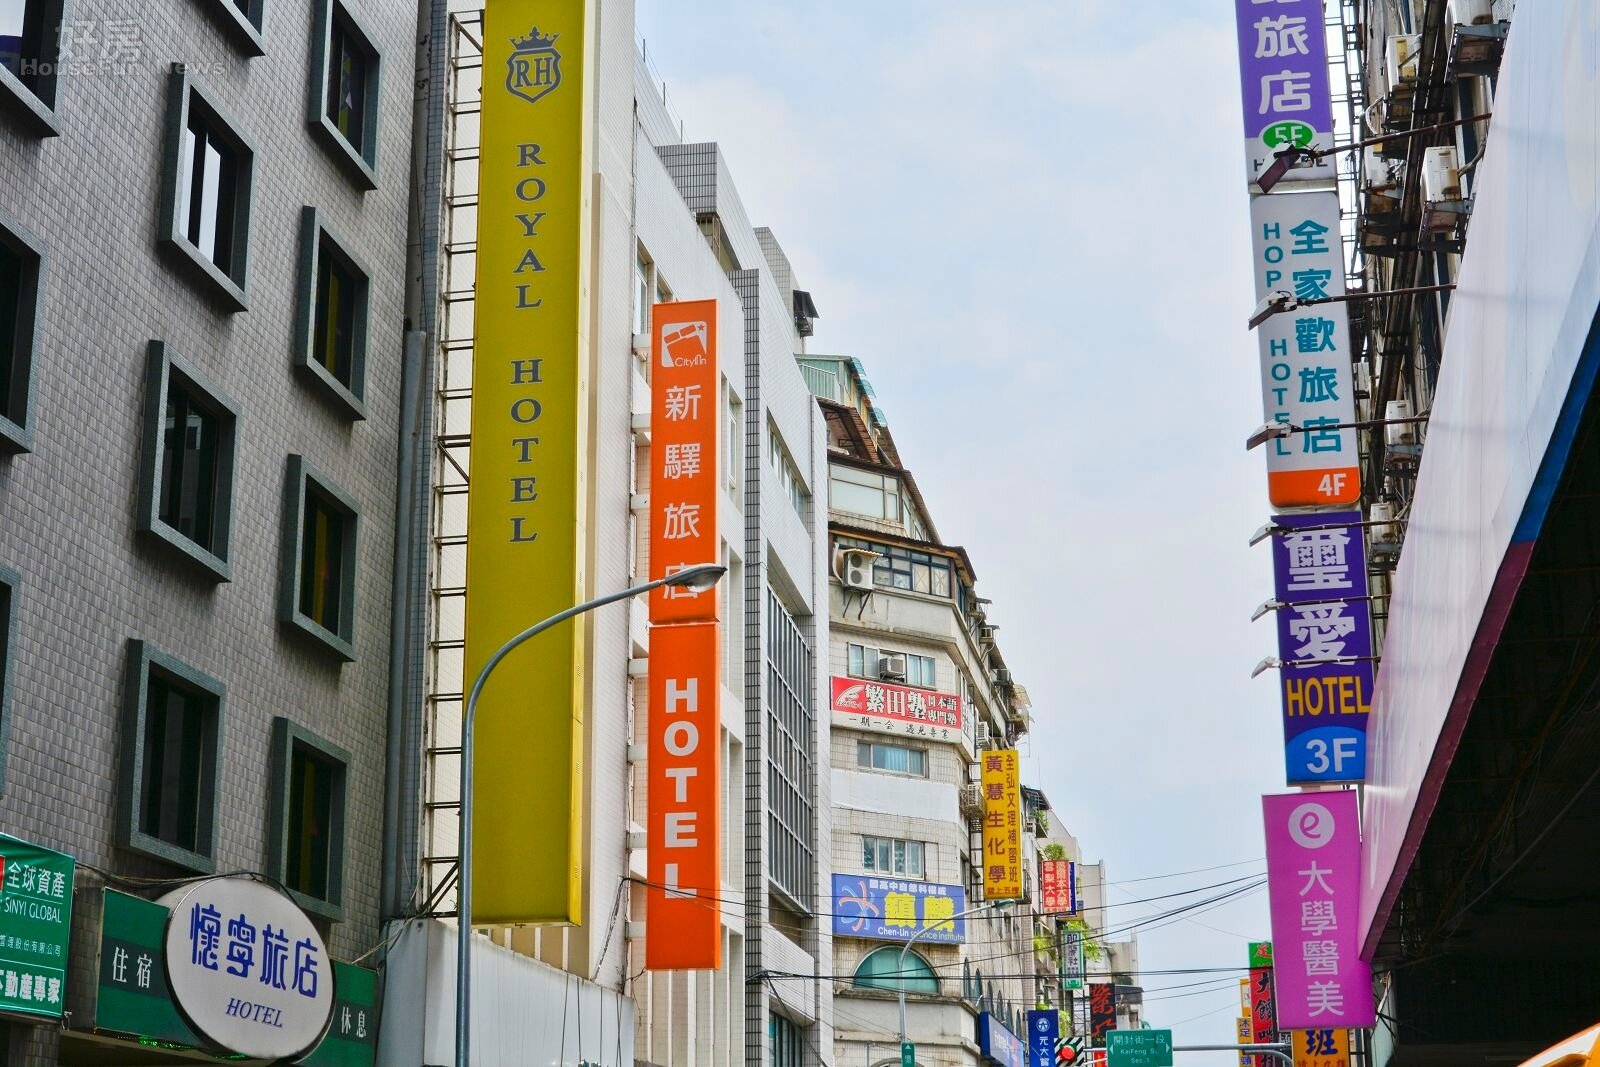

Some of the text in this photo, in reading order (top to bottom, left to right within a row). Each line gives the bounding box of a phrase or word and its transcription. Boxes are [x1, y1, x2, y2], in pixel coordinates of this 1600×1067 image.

[513, 57, 554, 89] RH
[1251, 0, 1311, 115] 旅店
[1274, 126, 1303, 148] 5F
[508, 143, 547, 543] ROYAL HOTEL
[1289, 219, 1342, 454] 全家歡旅店
[1317, 473, 1347, 497] 4F
[1286, 676, 1371, 717] HOTEL
[1306, 737, 1357, 774] 3F
[664, 678, 701, 899] HOTEL
[6, 861, 66, 899] 全球資產
[4, 898, 62, 923] SINYI GLOBAL
[189, 901, 319, 999] 懷寧旅店
[878, 927, 909, 937] Chen-Lin
[1298, 860, 1344, 1017] 大學醫美
[112, 946, 153, 989] 住宿
[226, 997, 283, 1028] HOTEL
[341, 1006, 367, 1038] 休息
[1113, 1034, 1165, 1046] 開封街一段
